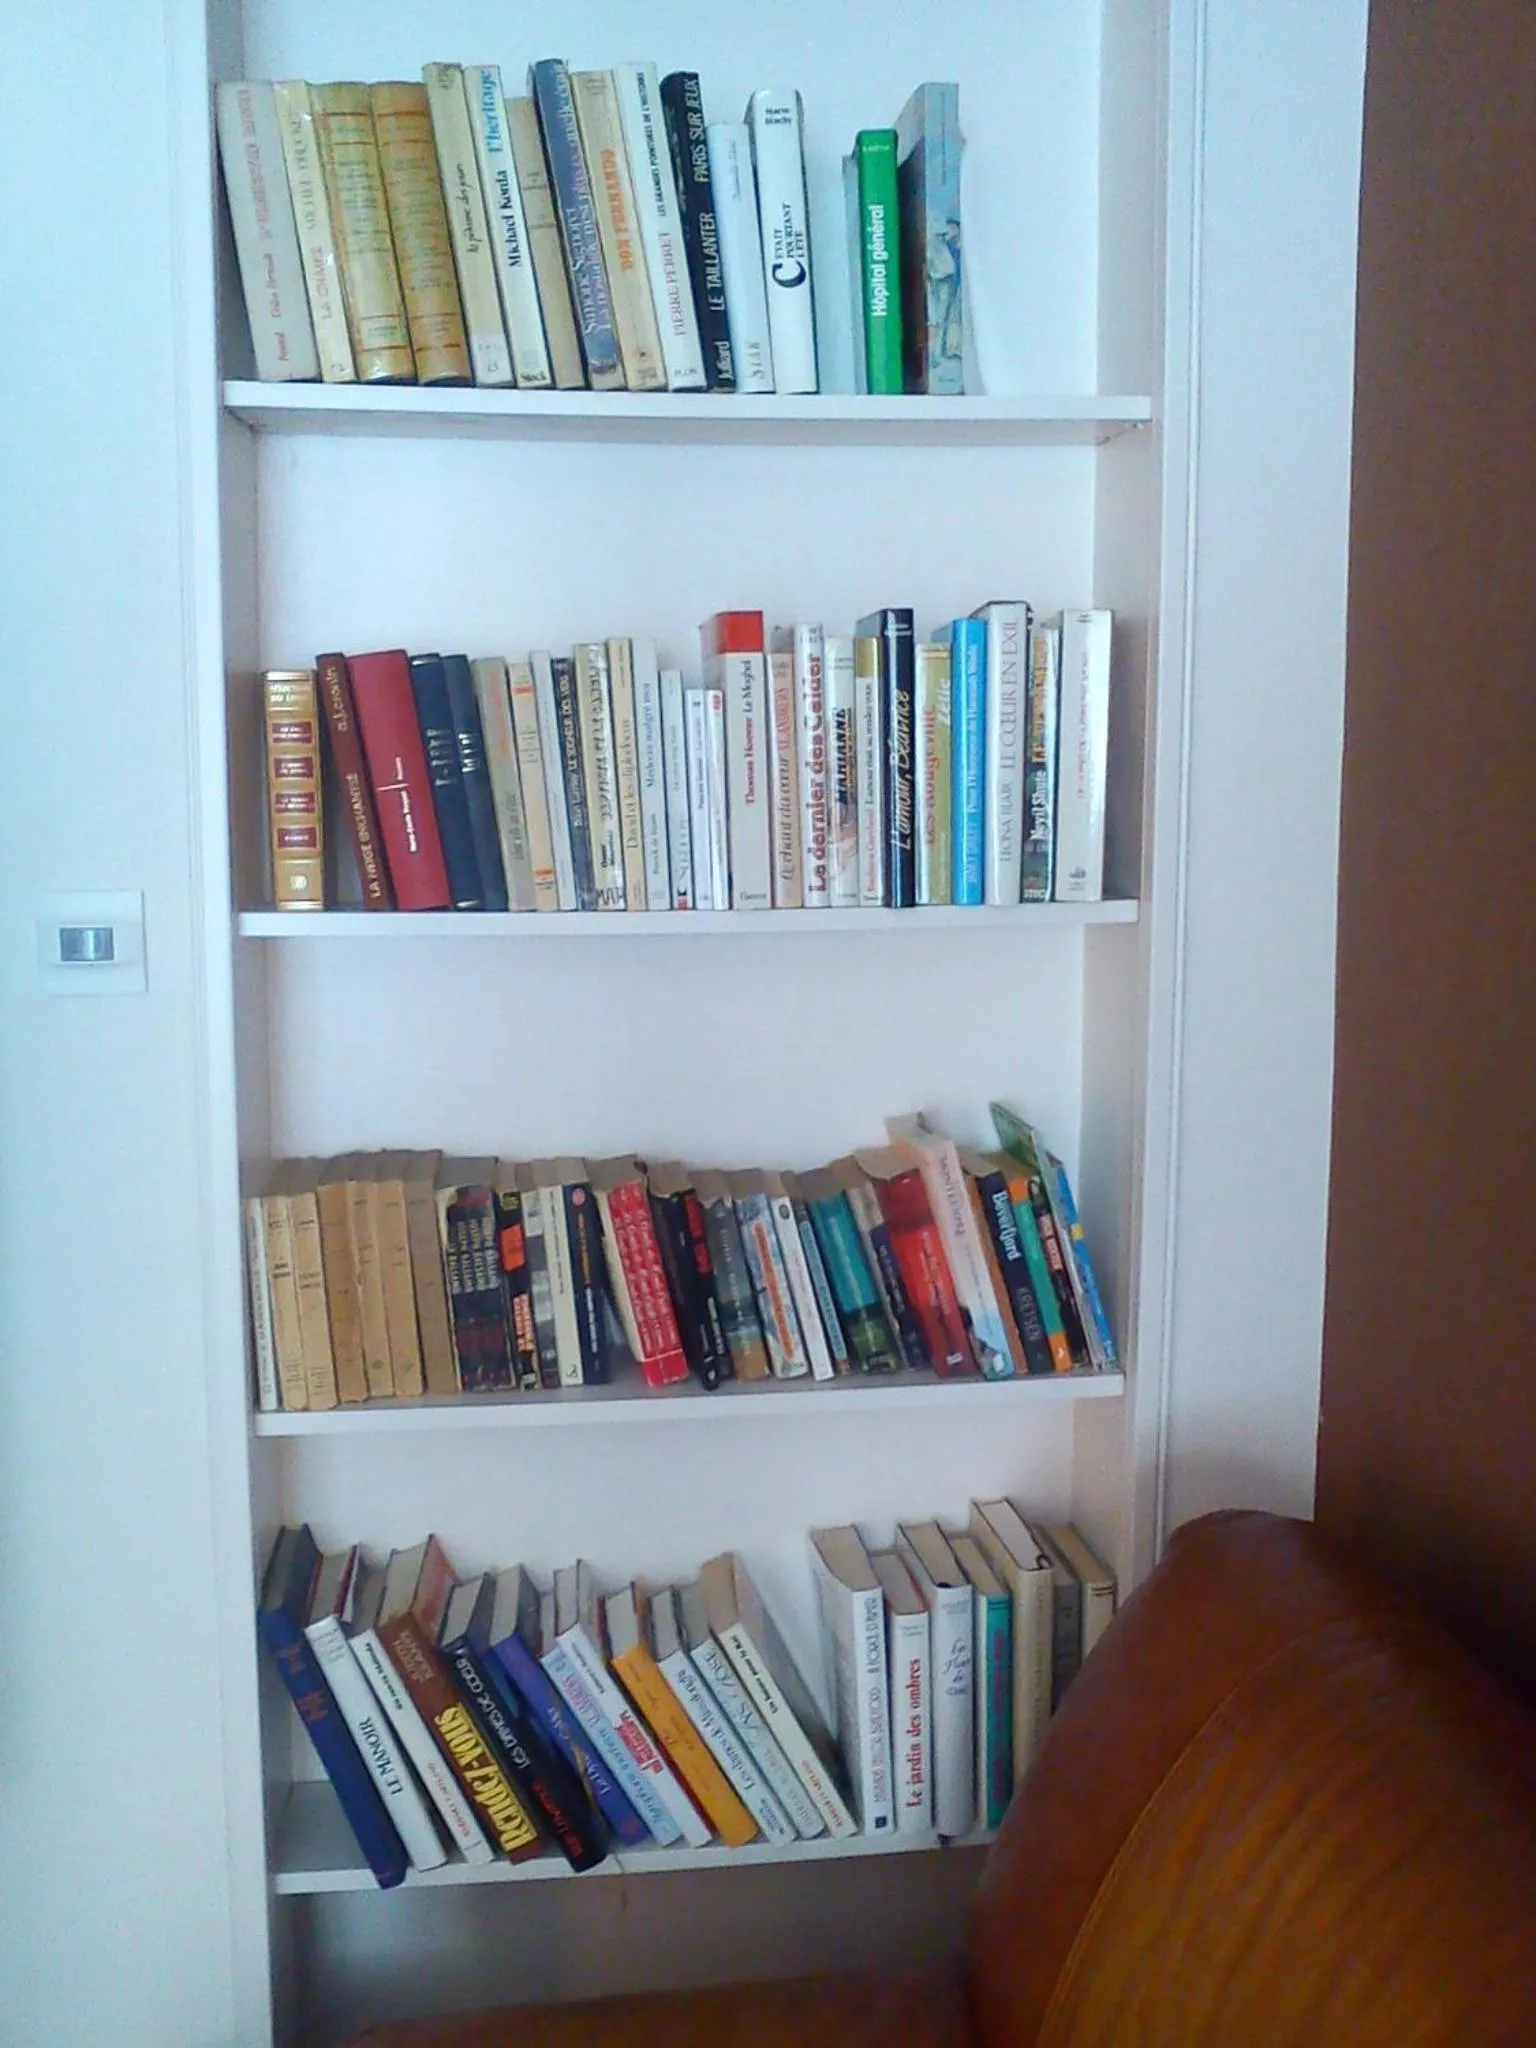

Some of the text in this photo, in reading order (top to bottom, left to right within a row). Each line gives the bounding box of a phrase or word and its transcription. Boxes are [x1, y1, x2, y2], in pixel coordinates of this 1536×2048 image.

[642, 113, 651, 123] DE
[644, 125, 657, 166] POINTURES
[683, 78, 709, 182] PARIS SUR JEUX
[600, 149, 633, 270] DON FERNANDO
[651, 168, 663, 202] GRANDES
[657, 203, 666, 217] LES
[494, 169, 521, 267] Michael Korda
[781, 203, 795, 259] POURTANT
[561, 206, 601, 334] Simone Signoret
[658, 231, 687, 336] PIERRE PERRET
[699, 212, 725, 312] LE TAILLANTER
[867, 204, 888, 317] Hôpital général
[715, 340, 733, 379] Julliard
[1000, 621, 1018, 656] EXIL
[740, 659, 755, 713] Le Moghol
[999, 658, 1017, 685] EN
[887, 689, 910, 769] Béatrice
[743, 717, 755, 804] Thomas Hoover
[801, 652, 827, 893] Le dernier des Calder
[835, 709, 849, 806] MARIANNE
[1000, 754, 1016, 769] LE
[776, 795, 792, 820] du
[1000, 782, 1013, 862] LEONA BLAIR
[1029, 768, 1047, 840] Nevil Shute
[776, 821, 793, 863] chant
[864, 807, 876, 892] Barbara Cartland
[369, 880, 381, 897] LA
[476, 1692, 496, 1713] DE
[488, 1709, 517, 1748] DAMES
[768, 1700, 778, 1714] Un
[359, 1717, 403, 1795] LE MANOIR
[511, 1745, 530, 1769] LES
[905, 1658, 925, 1807] Le jardin des ombres
[436, 1707, 531, 1848] Rendez-vous
[739, 1769, 756, 1791] Les
